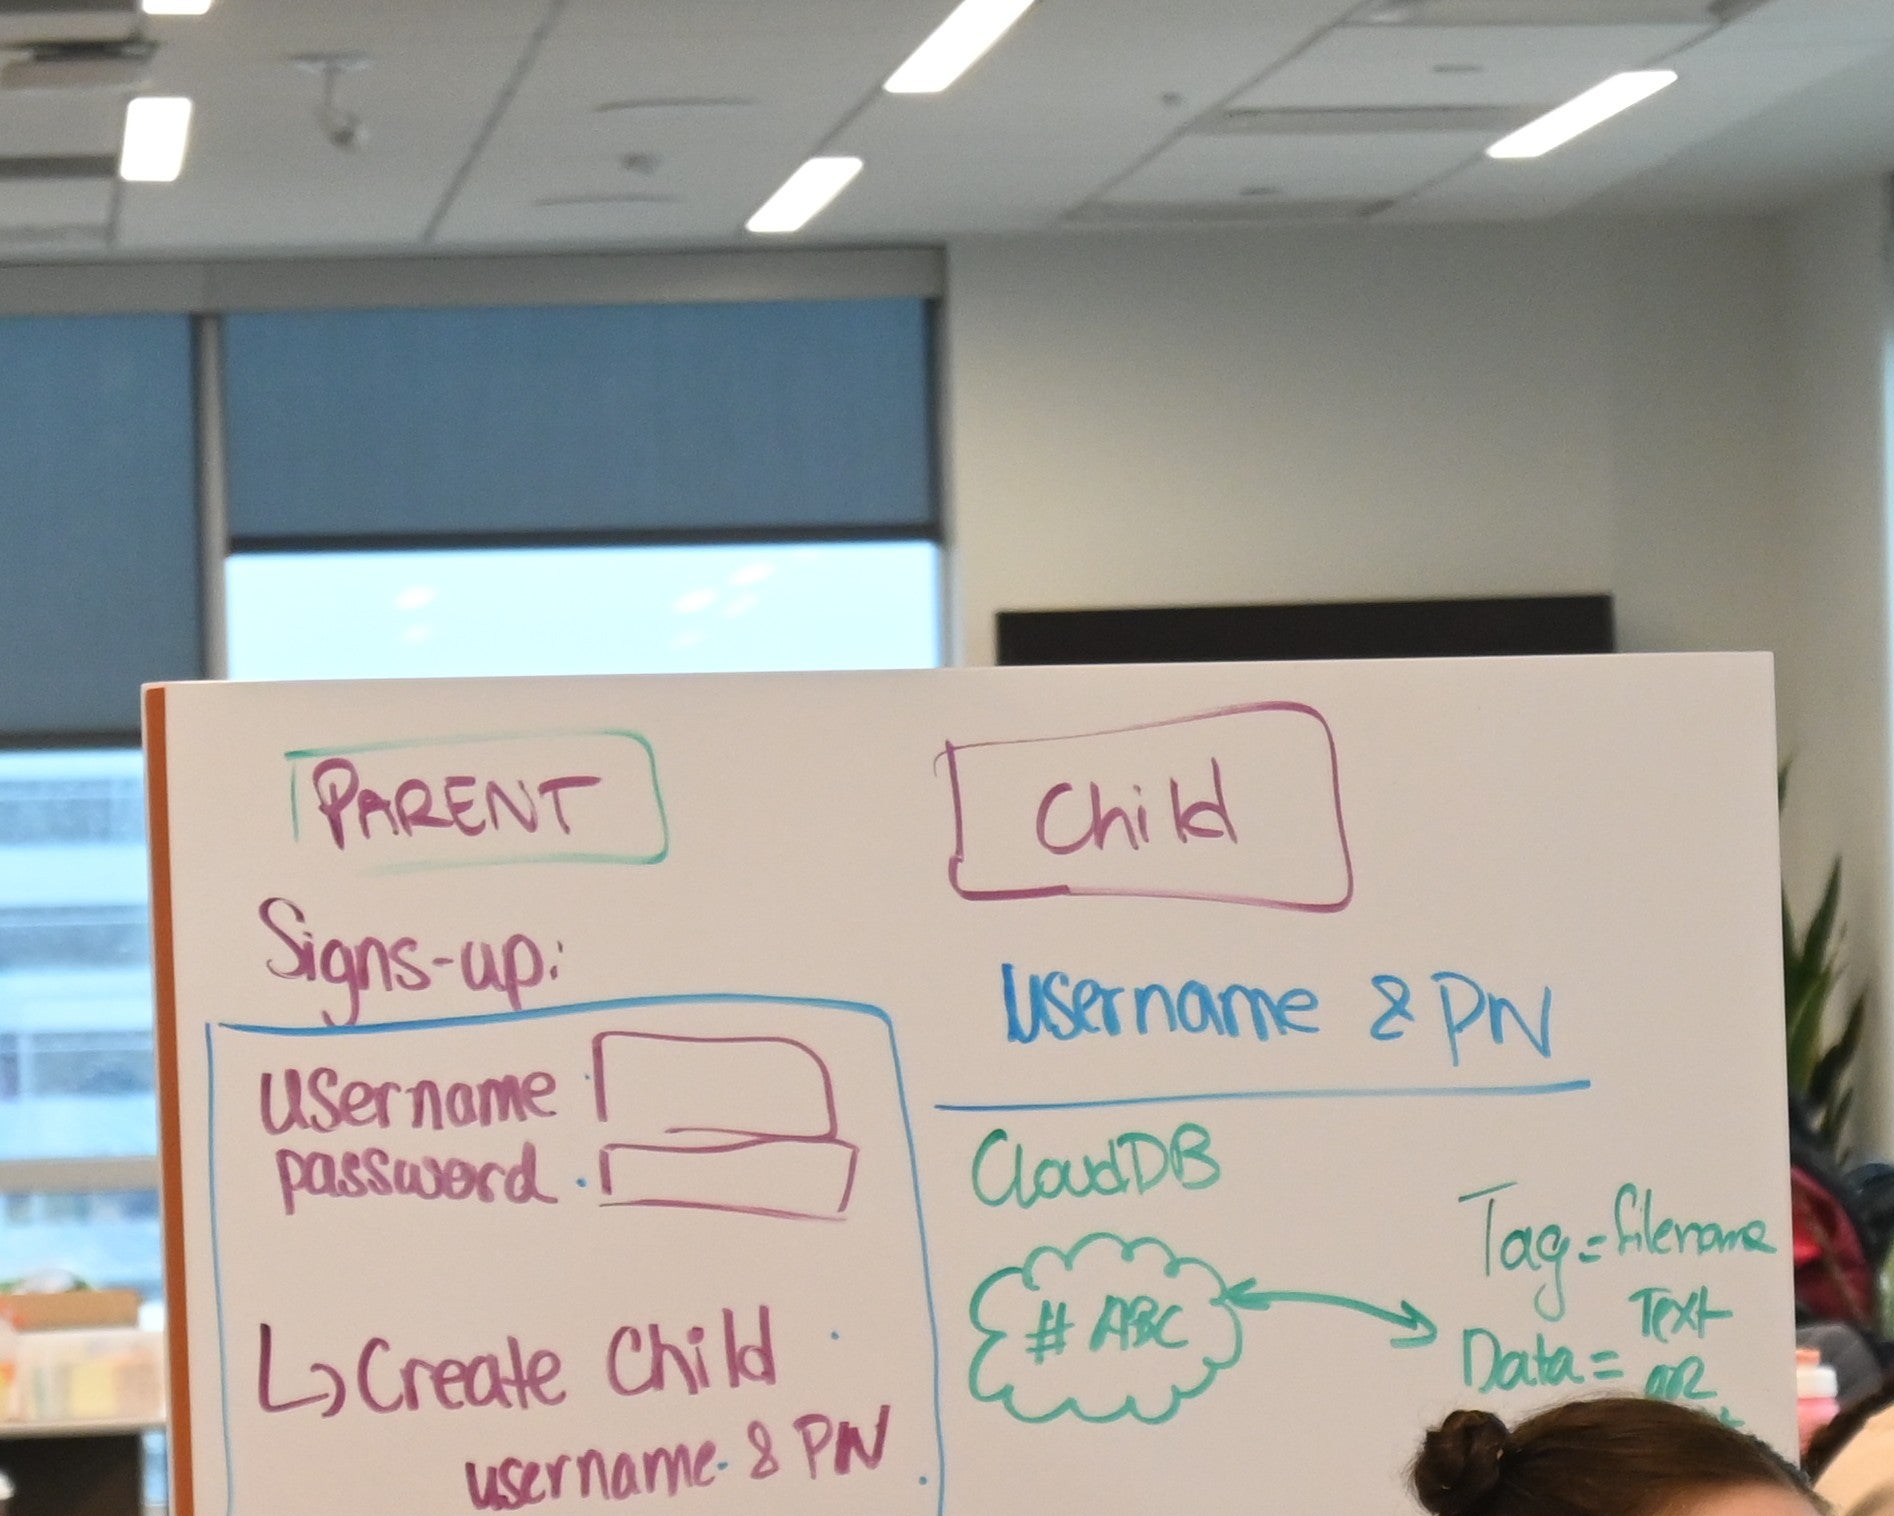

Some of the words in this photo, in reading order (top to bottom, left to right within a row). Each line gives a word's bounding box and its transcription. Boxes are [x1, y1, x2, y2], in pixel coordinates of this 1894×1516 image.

[312, 757, 602, 850] PARENT
[1036, 757, 1237, 855] Child
[276, 1141, 558, 1215] password
[358, 1337, 566, 1414] Create
